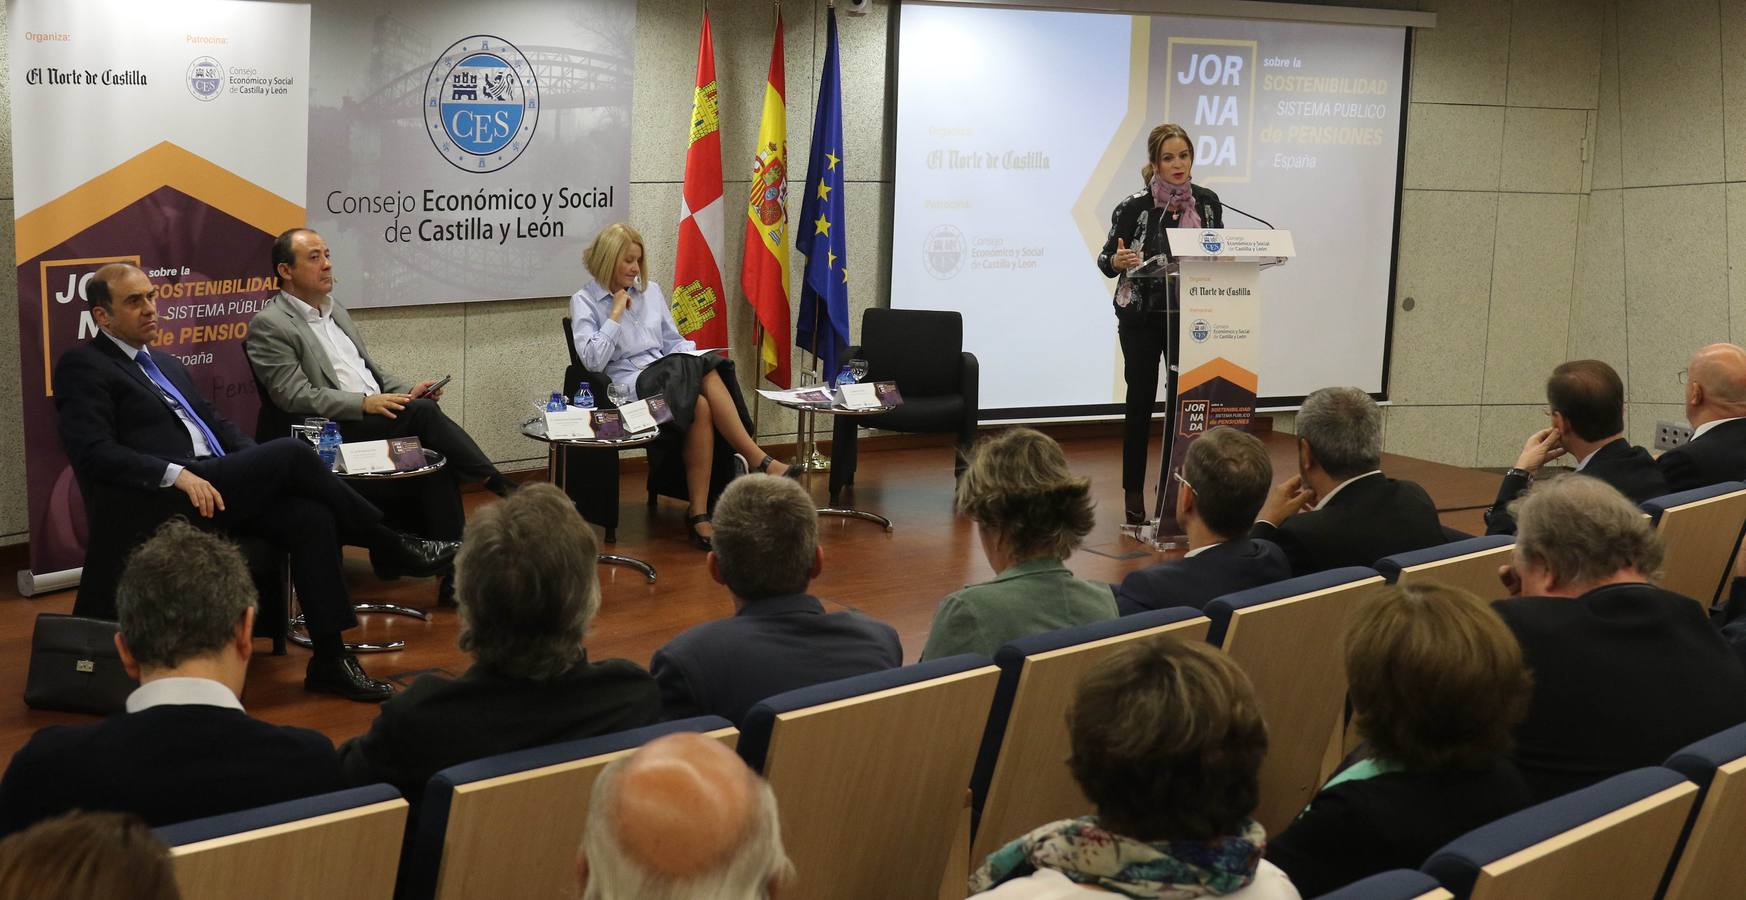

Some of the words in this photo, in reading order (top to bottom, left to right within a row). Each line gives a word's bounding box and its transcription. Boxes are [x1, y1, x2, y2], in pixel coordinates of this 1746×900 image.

[25, 32, 71, 43] Organiza:
[186, 35, 229, 44] Patrocina:
[1177, 54, 1243, 86] JOR
[1263, 57, 1290, 68] sobre
[1292, 57, 1302, 68] la
[26, 67, 43, 86] El
[47, 67, 83, 85] Norte
[85, 70, 98, 85] de
[101, 69, 148, 86] Castilla
[229, 66, 257, 77] Consejo
[195, 82, 216, 95] CES
[268, 78, 274, 87] y
[274, 76, 294, 86] Social
[1263, 75, 1388, 96] SOSTENIBILIDAD
[239, 86, 264, 94] Castilla
[265, 87, 271, 96] y
[1194, 95, 1239, 126] NA
[1276, 101, 1331, 117] SISTEMA
[451, 109, 510, 145] CES
[1260, 126, 1281, 143] de
[1288, 126, 1384, 145] PENSIONES
[1194, 135, 1237, 167] DA
[927, 150, 943, 169] El
[948, 150, 982, 169] Norte
[986, 152, 999, 169] de
[1002, 150, 1051, 170] Castilla
[1273, 153, 1318, 170] España
[327, 190, 416, 219] Consejo
[422, 188, 537, 212] Económico
[542, 193, 553, 216] y
[558, 186, 613, 209] Social
[384, 219, 412, 243] de
[418, 217, 493, 242] Castilla
[499, 223, 511, 245] y
[517, 216, 564, 239] León
[149, 266, 177, 278] sobre
[181, 266, 190, 276] la
[1189, 286, 1198, 296] El
[1200, 286, 1217, 296] Norte
[1218, 287, 1225, 296] de
[1226, 286, 1251, 296] Castilla
[167, 303, 225, 320] SISTEMA
[228, 298, 273, 315] PÚBLI
[150, 328, 174, 347] de
[179, 322, 249, 345] PENSIO
[1184, 403, 1206, 412] JOR
[1189, 413, 1204, 422] NA
[1189, 422, 1203, 431] DA
